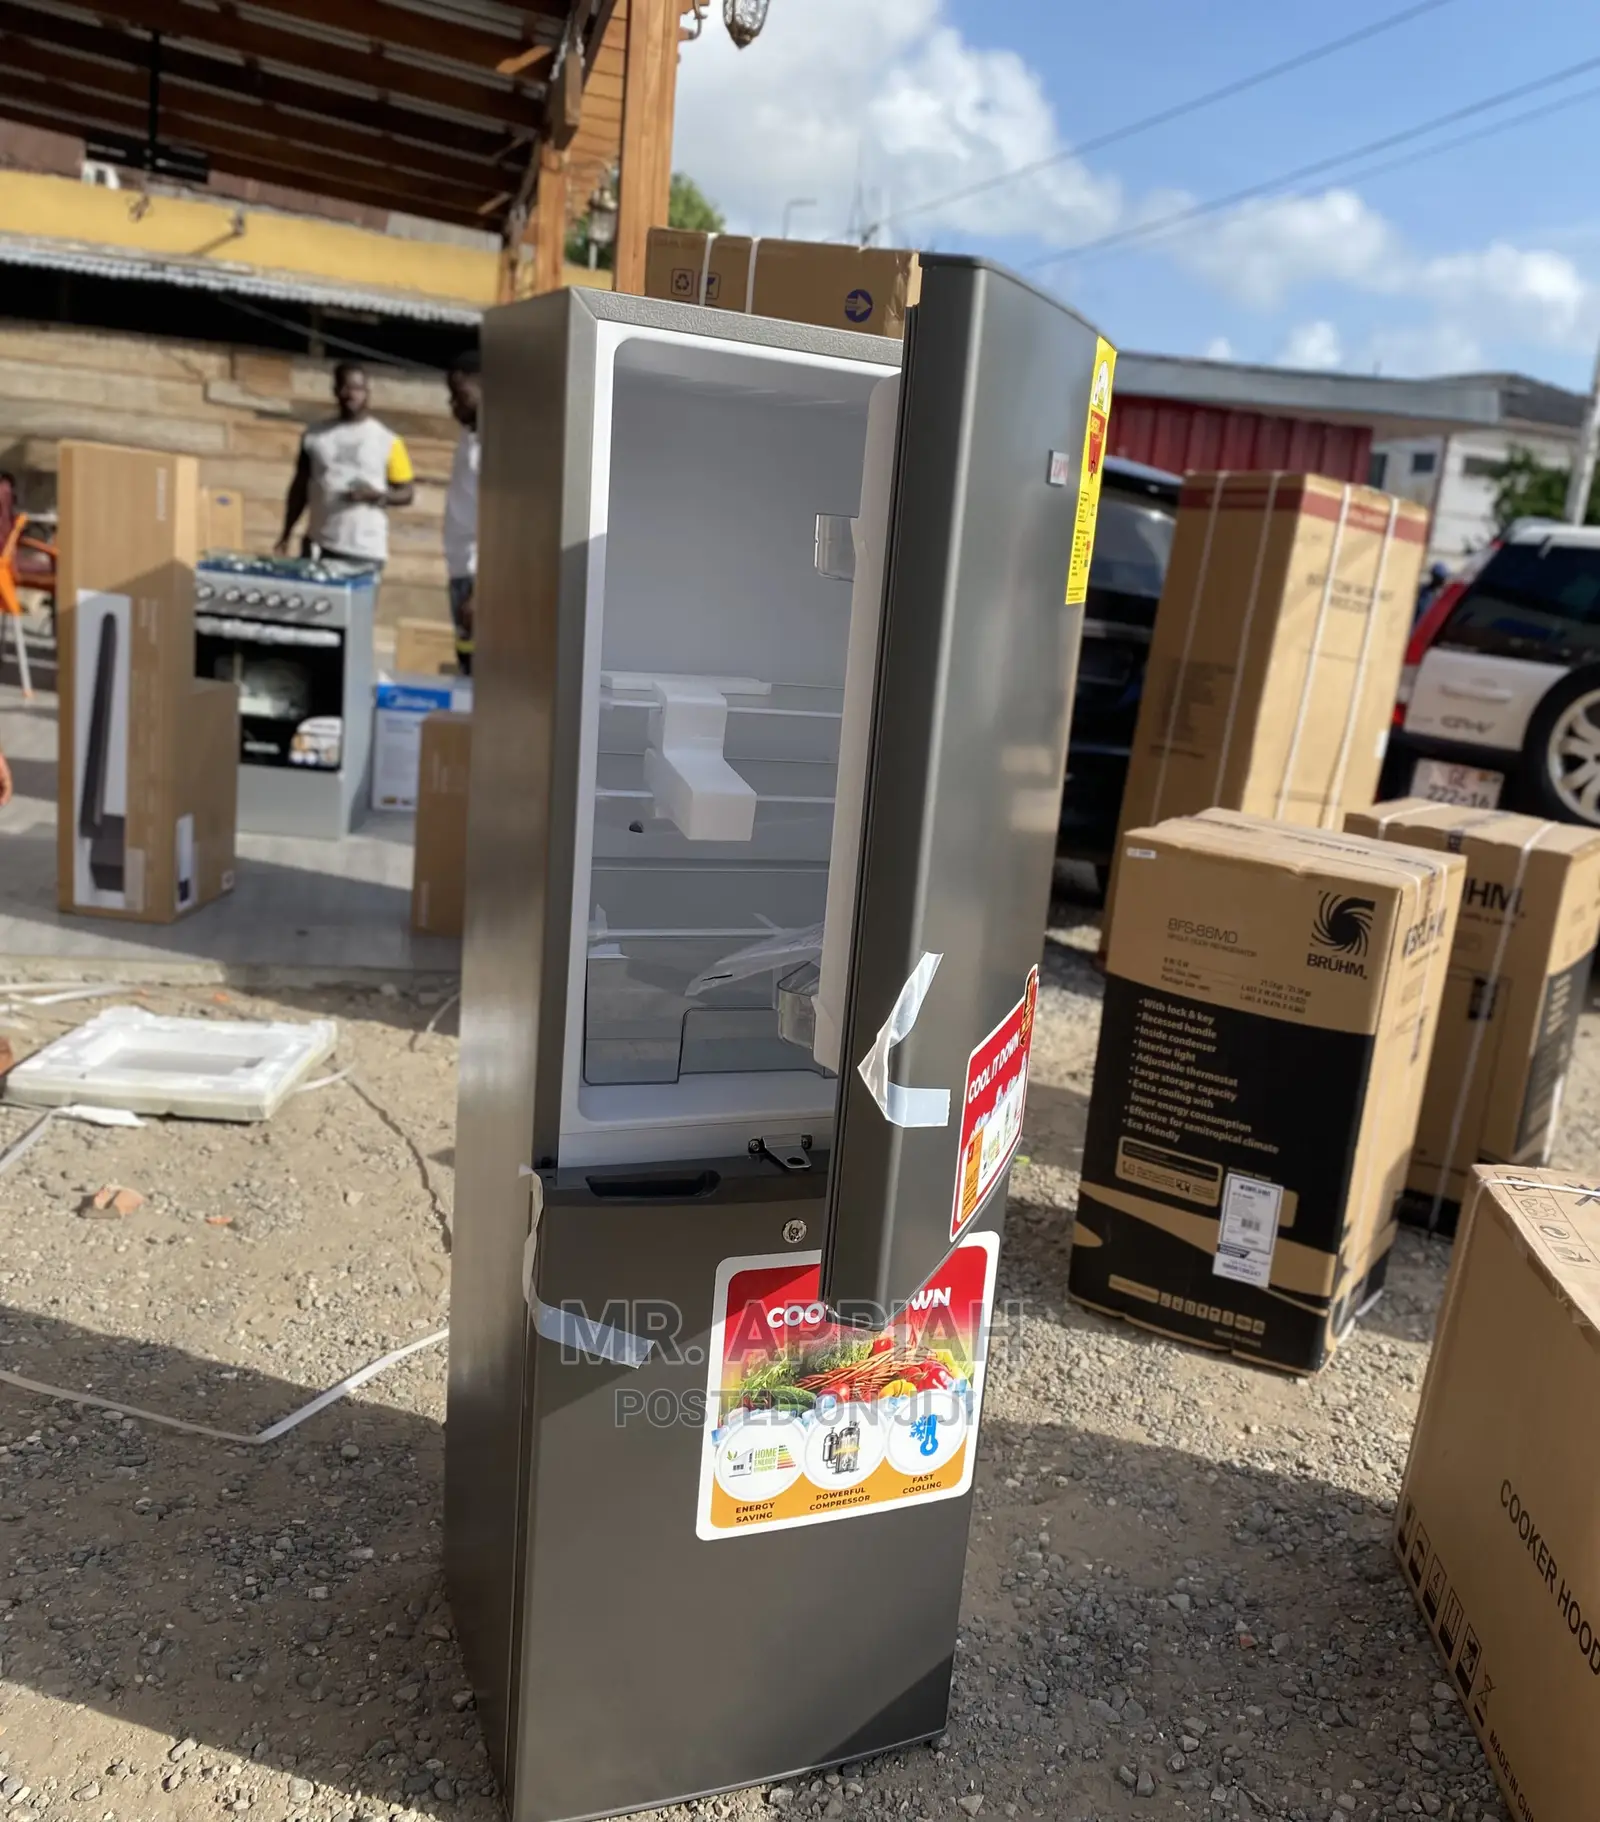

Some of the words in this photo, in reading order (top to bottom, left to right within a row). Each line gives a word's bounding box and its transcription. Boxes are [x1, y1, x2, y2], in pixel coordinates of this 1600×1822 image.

[1143, 998, 1166, 1012] With
[1167, 1004, 1187, 1018] lock
[1188, 1010, 1196, 1020] &
[1197, 1011, 1215, 1026] key
[1140, 1025, 1168, 1041] Inside
[1168, 1034, 1217, 1053] condenser
[1142, 1012, 1184, 1031] Recessed
[1184, 1022, 1217, 1040] handle
[1138, 1039, 1173, 1056] Interior
[1174, 1047, 1196, 1063] light
[967, 1064, 991, 1105] COOL
[991, 1053, 1001, 1081] IT
[999, 1027, 1021, 1072] DOWN
[1136, 1053, 1186, 1073] Adjustable
[1186, 1065, 1239, 1088] thermostat
[1132, 1079, 1157, 1093] Extra
[1158, 1086, 1192, 1105] cooling
[1193, 1096, 1215, 1109] with
[1134, 1065, 1161, 1081] Large
[1161, 1074, 1197, 1091] storage
[1197, 1084, 1238, 1103] capacity
[1130, 1091, 1156, 1107] lower
[1157, 1100, 1189, 1118] energy
[1190, 1109, 1252, 1133] consumption
[1126, 1118, 1144, 1130] Eco
[1144, 1122, 1181, 1144] friendly
[1128, 1104, 1168, 1124] Effective
[1169, 1117, 1184, 1129] for
[1184, 1122, 1242, 1144] semitropical
[1242, 1136, 1280, 1155] climate
[911, 1287, 951, 1311] WN
[766, 1302, 828, 1329] COO
[754, 1447, 777, 1460] HOME
[902, 1481, 942, 1494] COOLING
[912, 1474, 935, 1484] FAST
[735, 1501, 776, 1514] ENERGY
[809, 1494, 871, 1511] COMPRESSOR
[816, 1487, 866, 1501] POWERFUL
[735, 1511, 773, 1524] SAVING
[1500, 1479, 1558, 1594] COOKER
[1557, 1578, 1600, 1675] HOOD
[1489, 1729, 1511, 1779] MADE
[1509, 1773, 1519, 1796] IN
